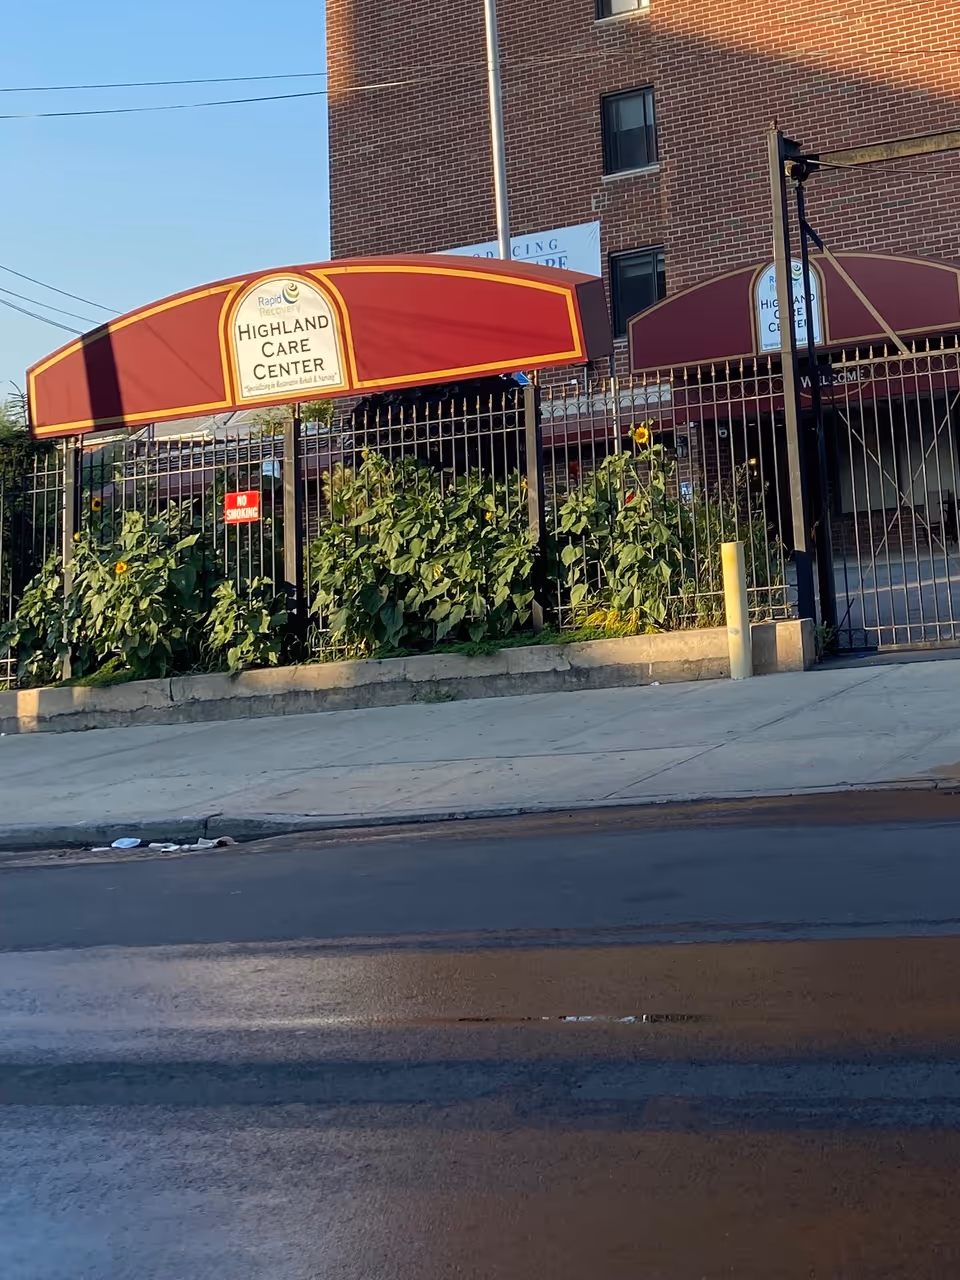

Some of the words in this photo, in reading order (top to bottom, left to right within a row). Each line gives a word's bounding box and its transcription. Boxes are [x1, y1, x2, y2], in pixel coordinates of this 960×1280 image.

[473, 239, 558, 258] DCING
[258, 294, 281, 307] Rapid
[761, 293, 815, 310] HIGAND
[259, 304, 301, 317] Recovery
[773, 307, 803, 320] CE
[238, 315, 329, 341] HIGHLAND
[768, 319, 807, 332] CEE
[261, 337, 311, 358] CARE
[253, 358, 325, 380] CENTER
[237, 495, 247, 507] NO
[226, 507, 258, 520] SMOKING
